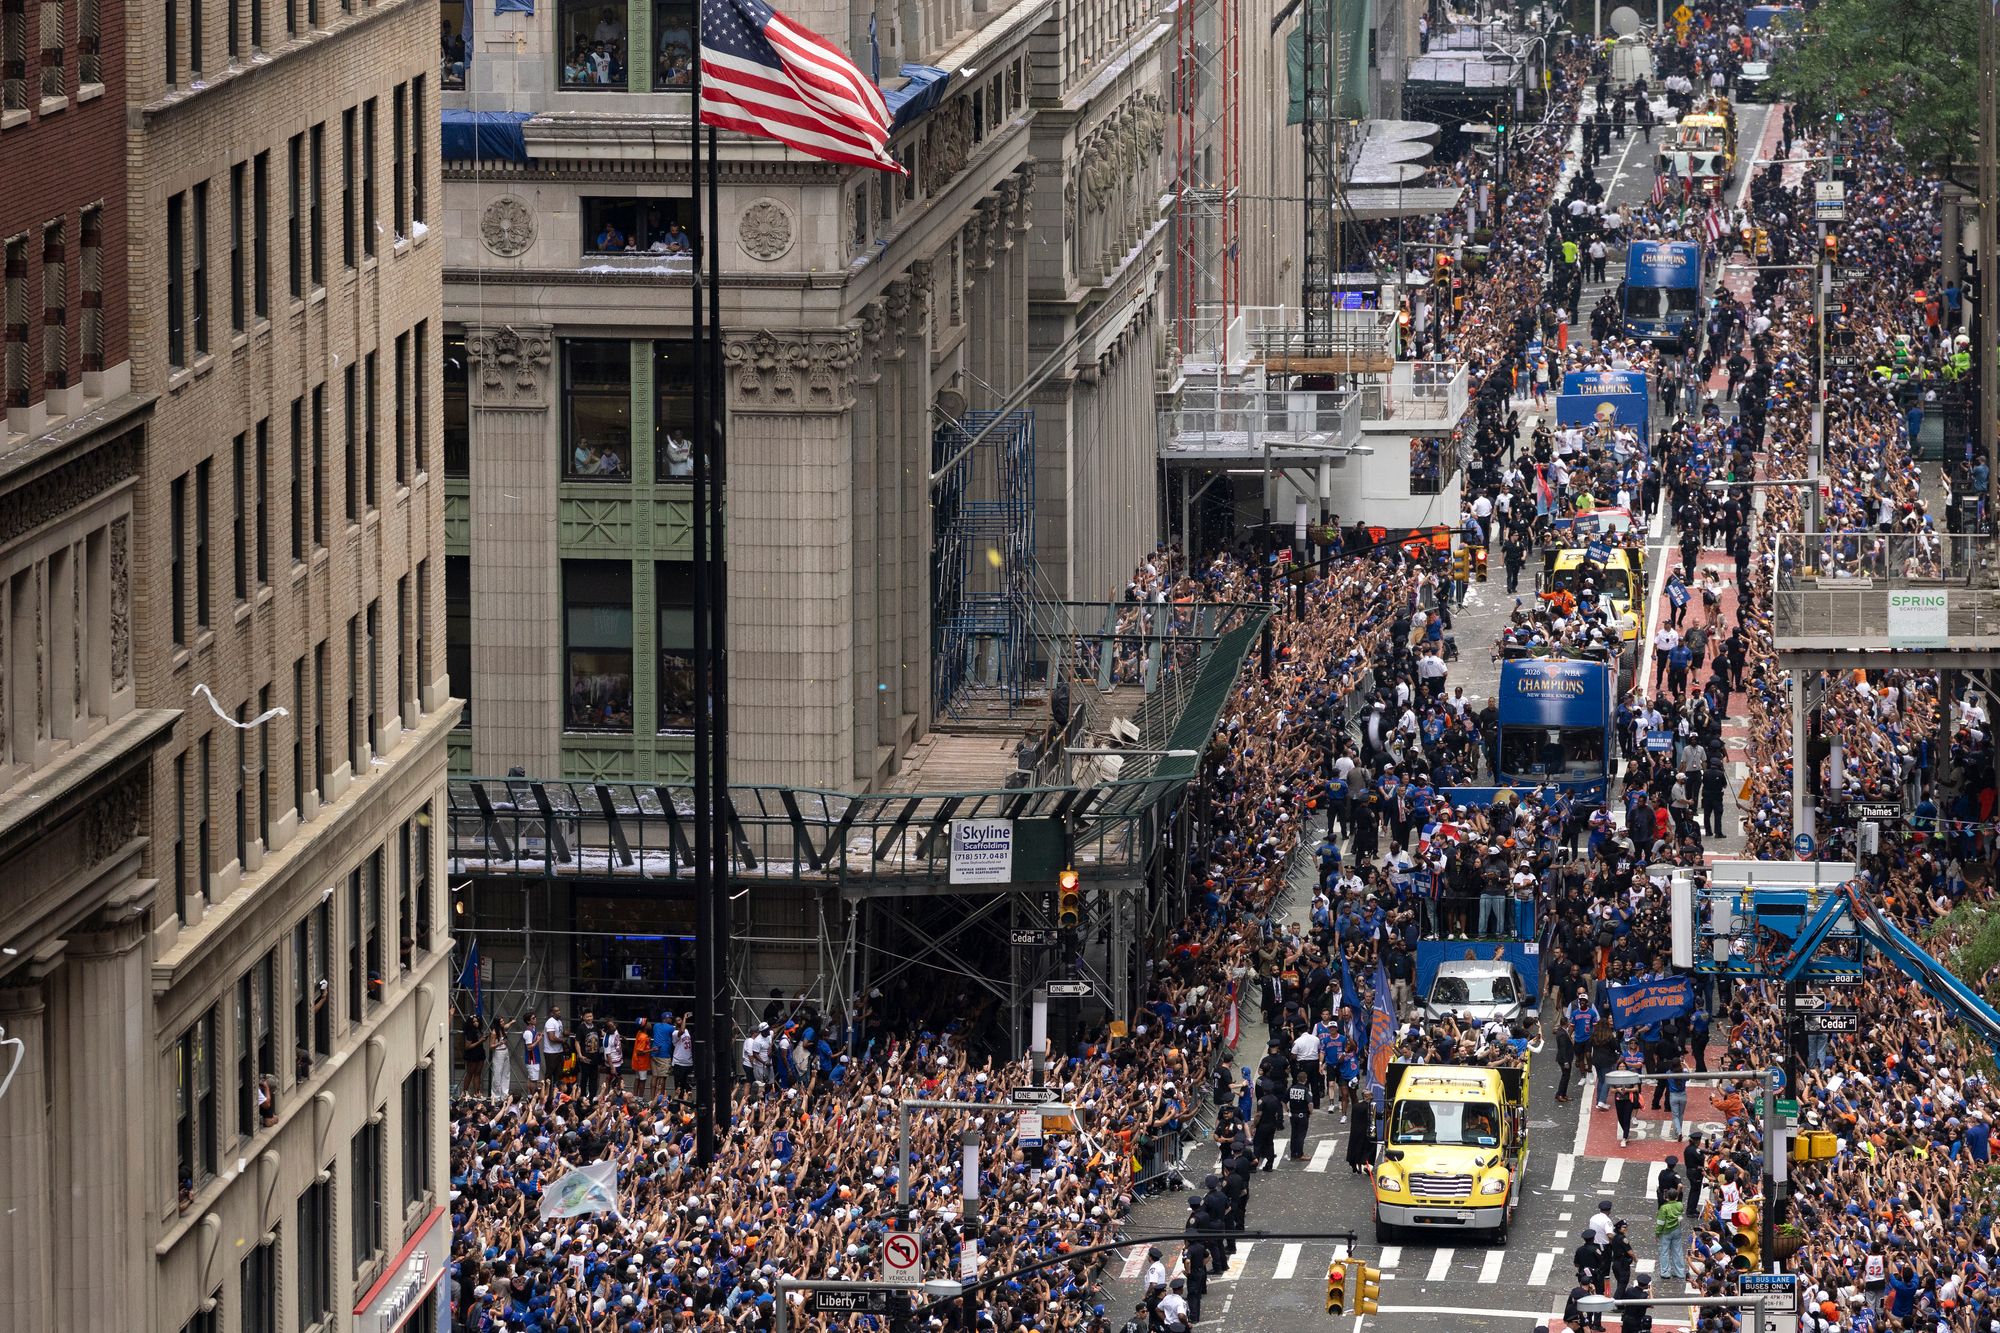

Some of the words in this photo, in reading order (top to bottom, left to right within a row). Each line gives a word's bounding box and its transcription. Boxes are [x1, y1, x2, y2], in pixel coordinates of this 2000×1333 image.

[1642, 254, 1687, 264] CHAMPIONS
[1580, 384, 1632, 394] CHAMPIONS
[1892, 596, 1945, 606] SPRING
[1518, 679, 1584, 694] CHAMPIONS
[1863, 807, 1892, 816] Thames
[963, 825, 1010, 843] Skyline
[964, 842, 1008, 850] Scaffolding
[1012, 934, 1036, 943] Cedar
[1617, 989, 1647, 1008] NEW
[1648, 981, 1687, 994] YORK
[1625, 995, 1684, 1017] FOREVER
[1822, 1019, 1848, 1029] Cedar
[1869, 1266, 1882, 1276] 32
[820, 1295, 856, 1309] Liberty
